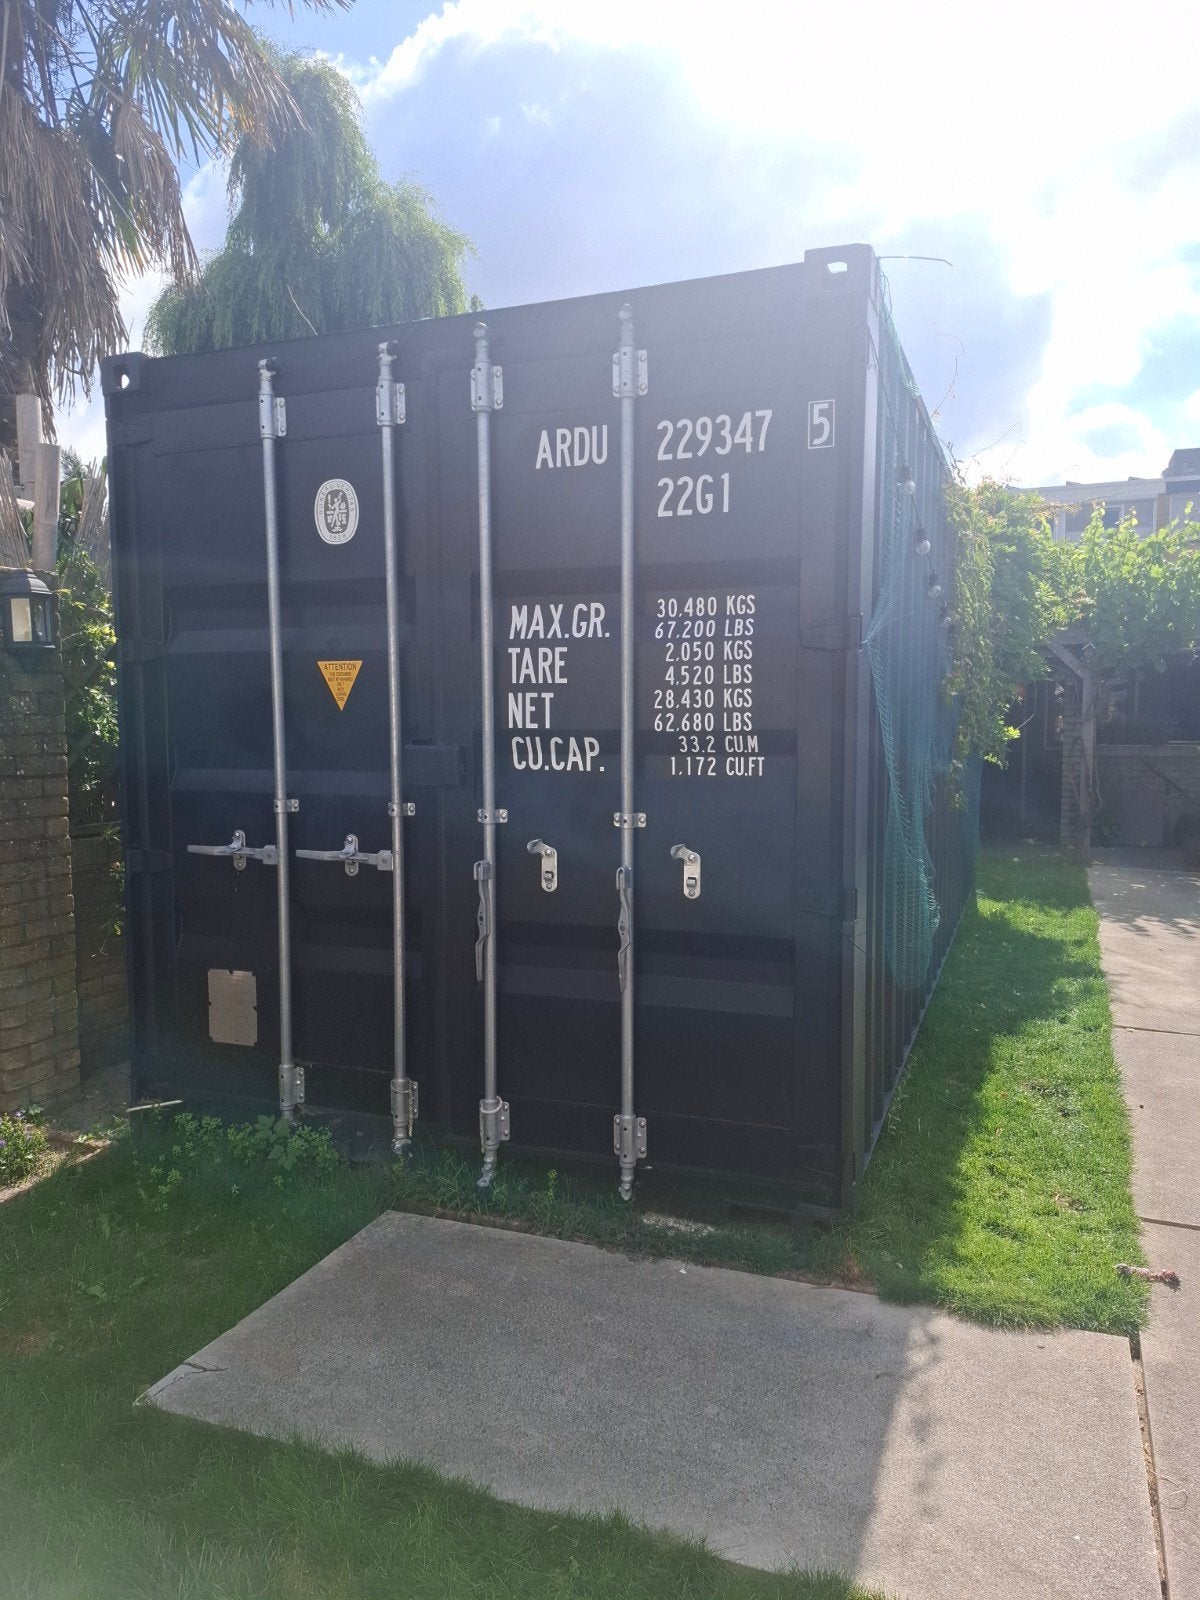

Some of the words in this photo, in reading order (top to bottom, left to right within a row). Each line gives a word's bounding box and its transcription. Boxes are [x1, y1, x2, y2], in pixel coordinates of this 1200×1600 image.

[535, 424, 608, 470] ARDU
[656, 408, 773, 461] 229347
[811, 402, 830, 445] 5
[656, 472, 730, 518] 22G1
[656, 596, 717, 618] 30,480
[726, 594, 756, 616] KGS
[509, 602, 610, 640] MAX.GR.
[654, 620, 716, 639] 67,200
[724, 618, 755, 637] LBS
[665, 641, 715, 662] 2,050
[723, 639, 753, 660] KGS
[324, 663, 357, 671] ATTENTION
[508, 646, 568, 684] TARE
[665, 664, 715, 685] 4,520
[723, 663, 753, 685] LBS
[654, 688, 715, 709] 28,430
[723, 687, 753, 709] KGS
[508, 692, 554, 729] NET
[654, 712, 715, 732] 62,680
[723, 711, 753, 732] LBS
[511, 736, 605, 772] CU.CAP.
[678, 735, 716, 753] 33.2
[724, 735, 759, 753] CU.M
[670, 756, 717, 776] 1,172
[725, 756, 765, 777] CU.FT
